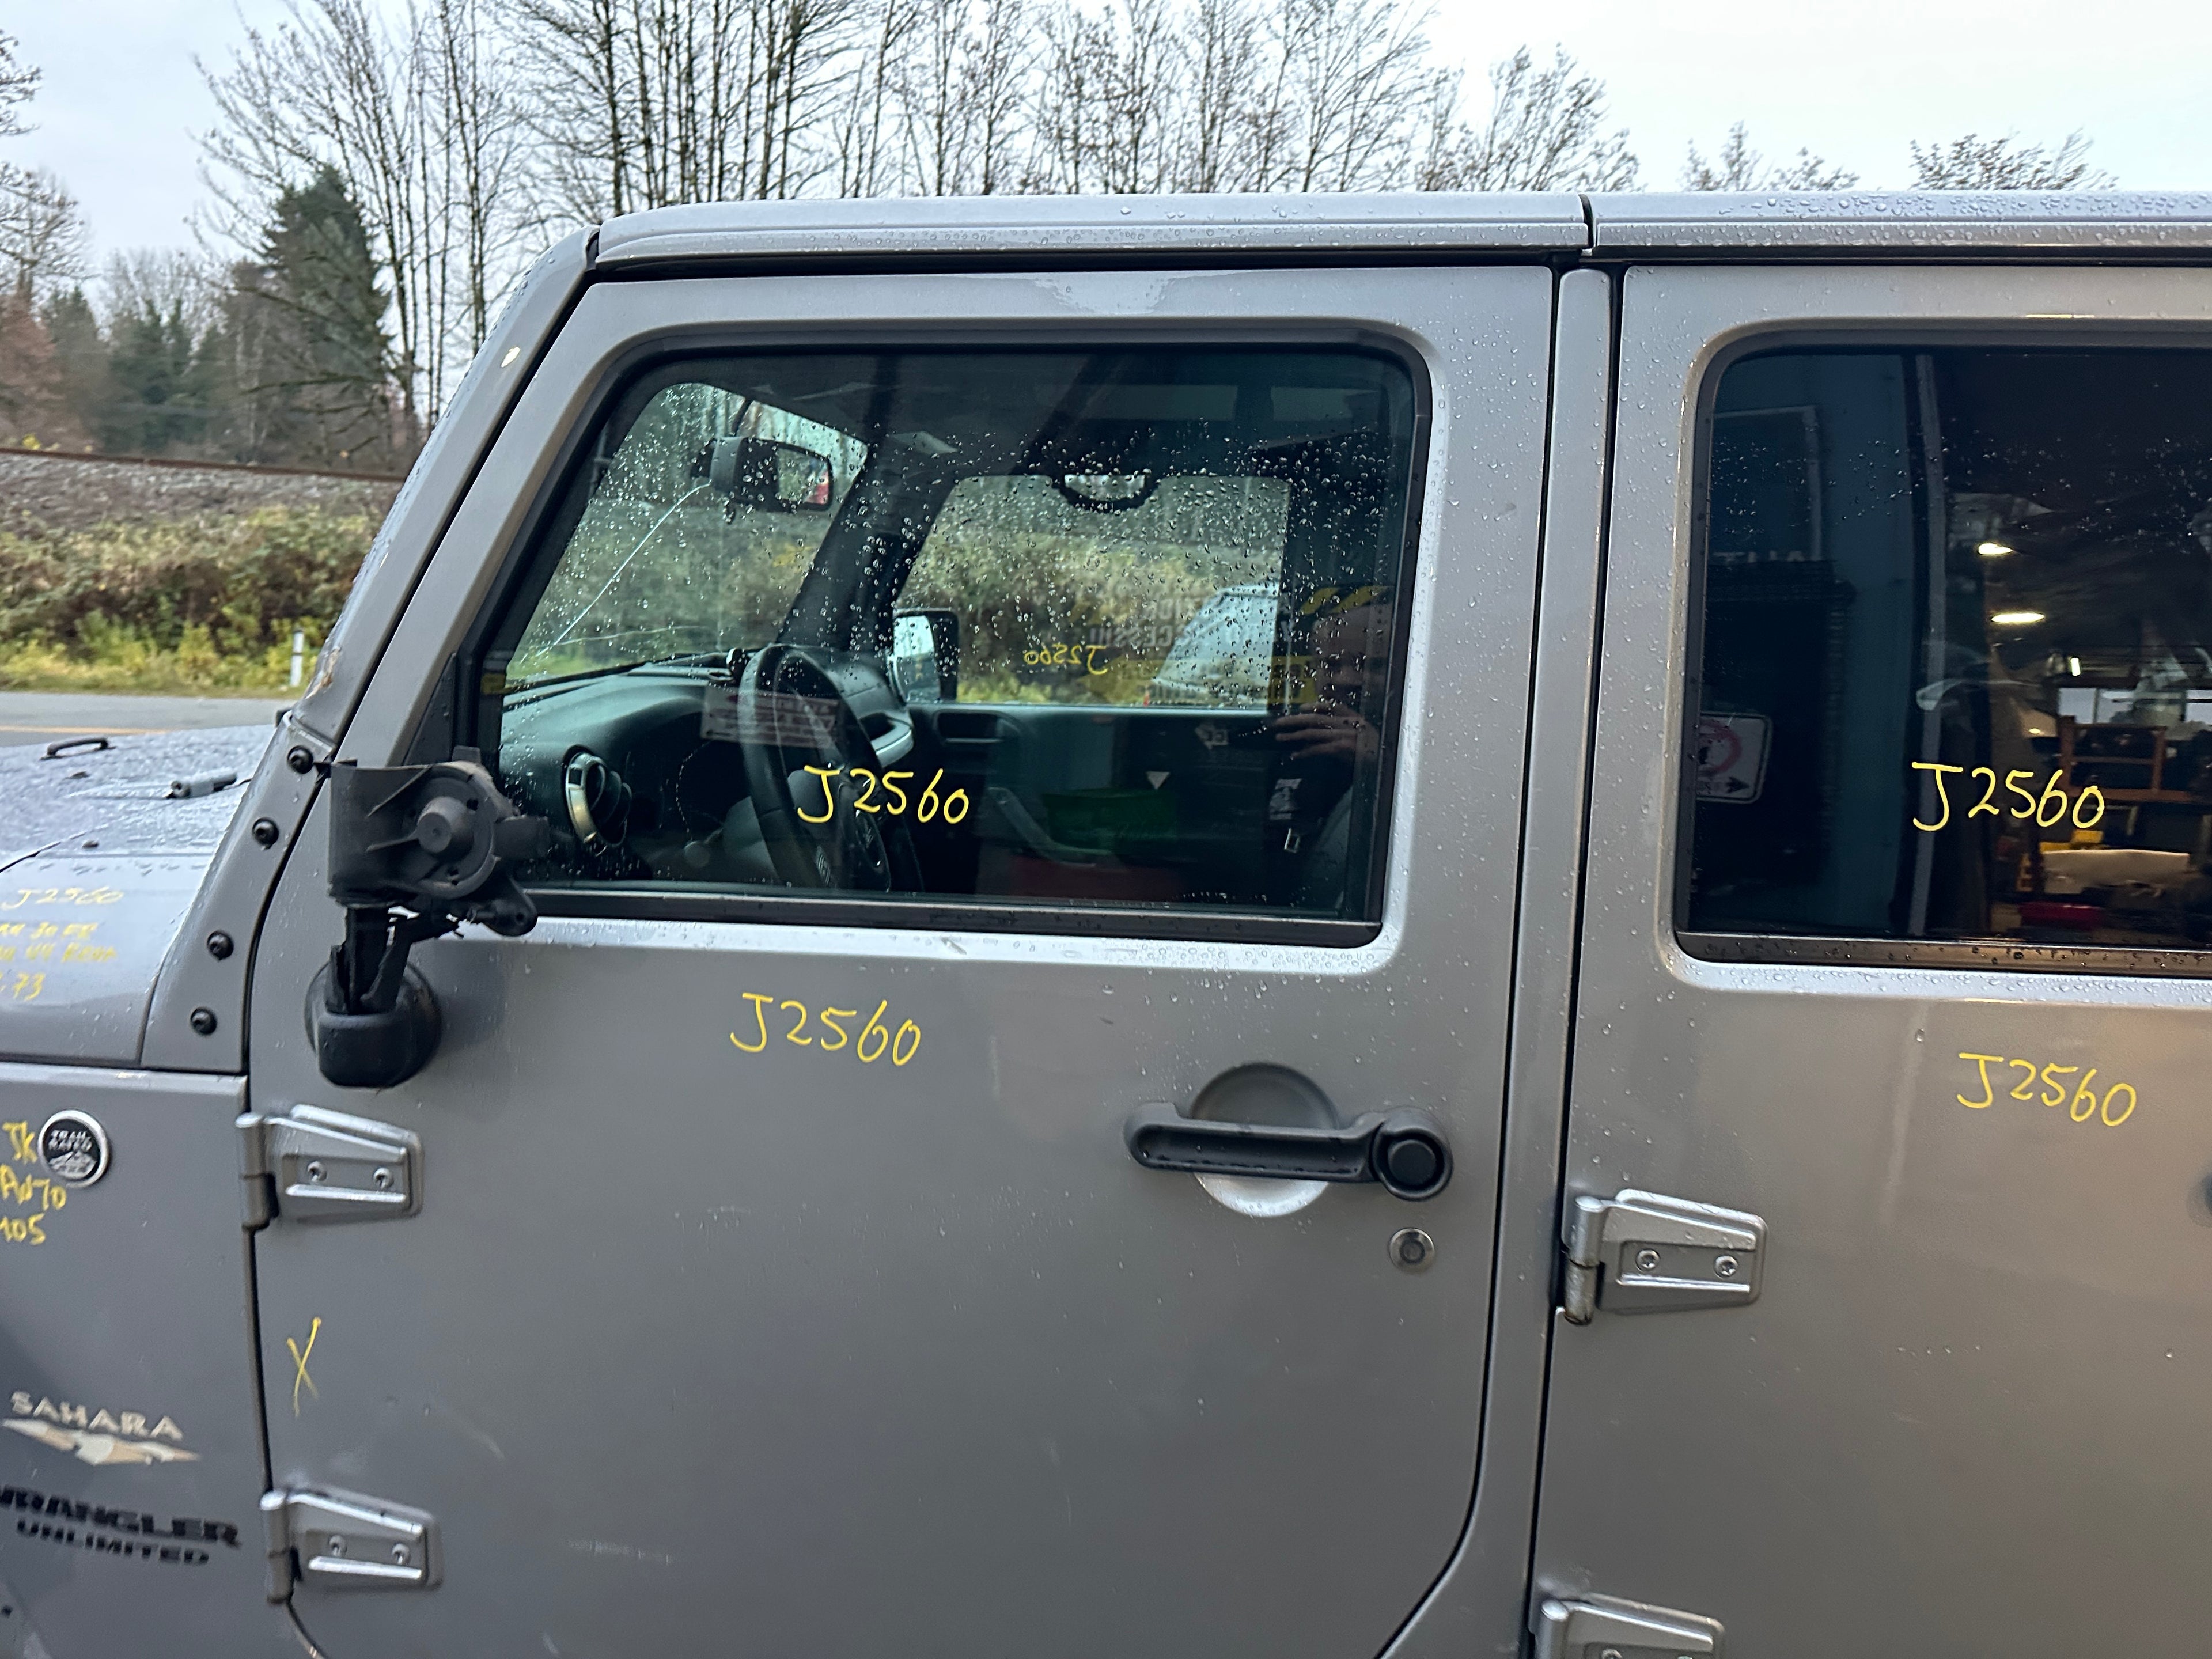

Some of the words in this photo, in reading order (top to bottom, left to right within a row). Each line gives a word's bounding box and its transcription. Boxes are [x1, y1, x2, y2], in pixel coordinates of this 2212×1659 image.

[797, 764, 969, 824] J2560
[1911, 762, 2105, 831] J2560
[730, 992, 921, 1066] J2560
[1957, 1052, 2137, 1127] J2560
[10, 1391, 184, 1441] SAHARA
[17, 1518, 210, 1565] UNLIMITED
